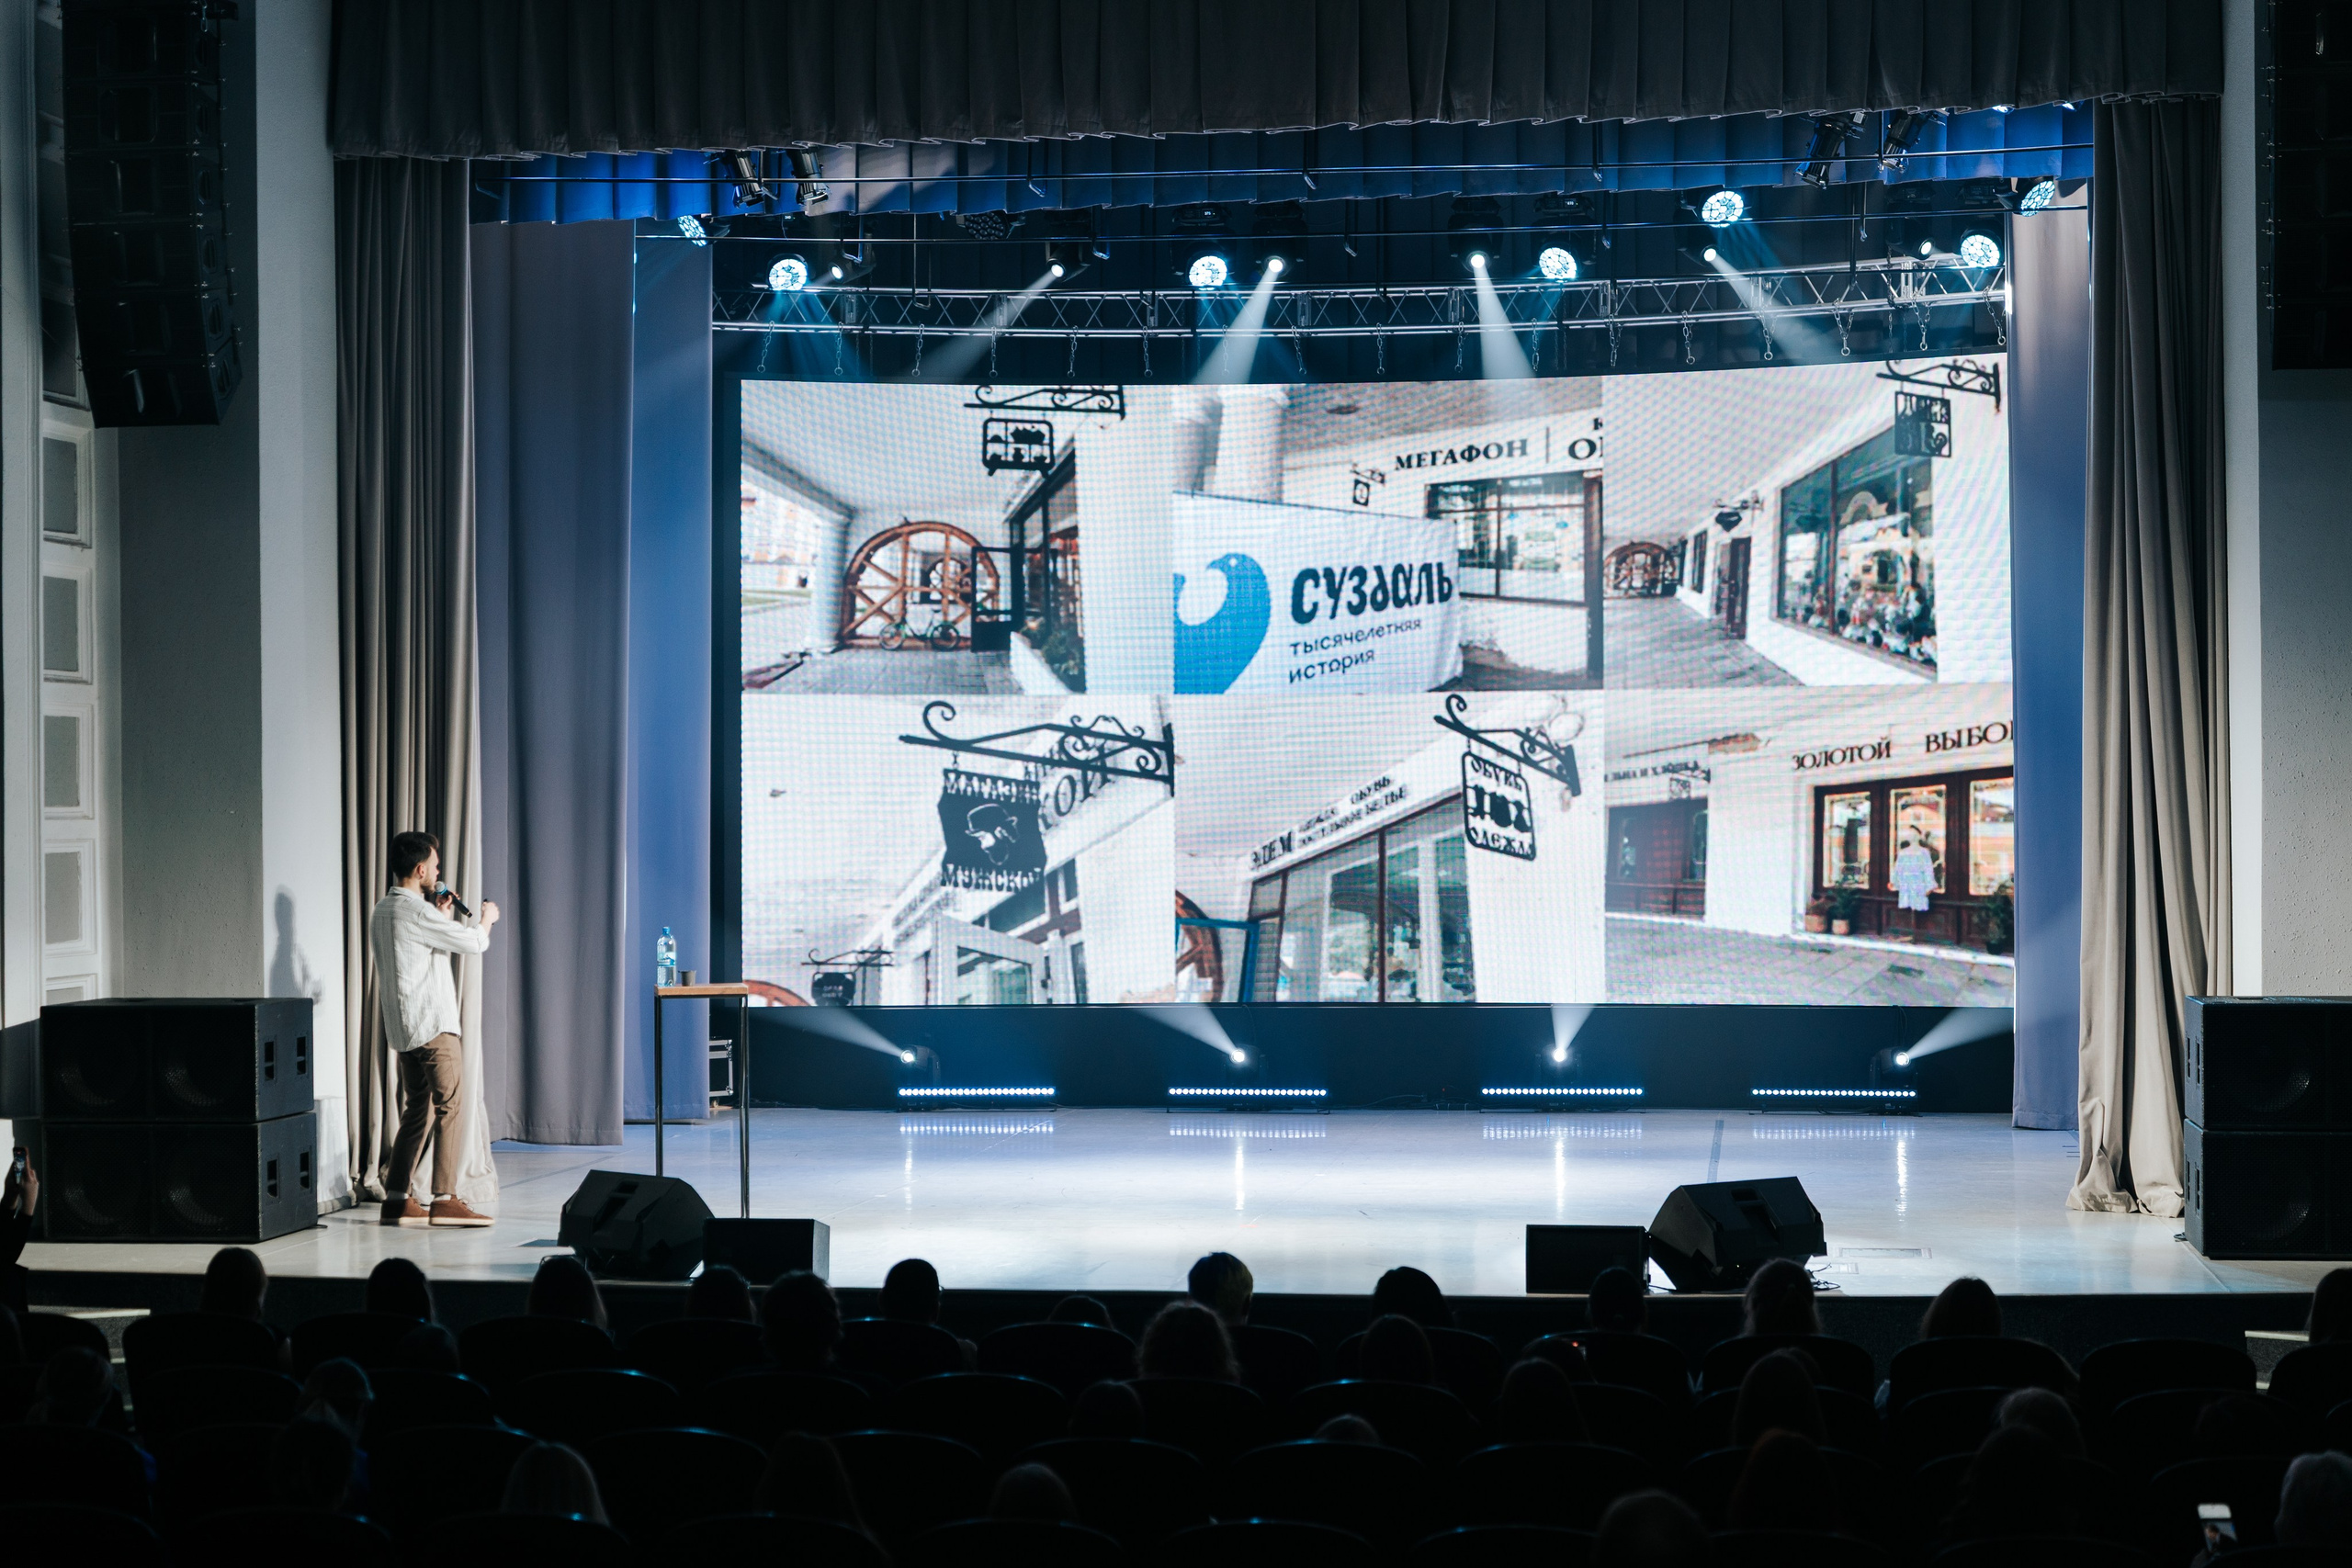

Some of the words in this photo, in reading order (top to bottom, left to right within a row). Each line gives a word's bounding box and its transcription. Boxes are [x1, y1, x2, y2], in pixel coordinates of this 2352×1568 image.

[1395, 438, 1529, 470] МЕГАФОН
[1567, 436, 1603, 460] О
[1792, 736, 1892, 770] ЗОЛОТОЙ
[1925, 719, 2014, 753] ВЫБО
